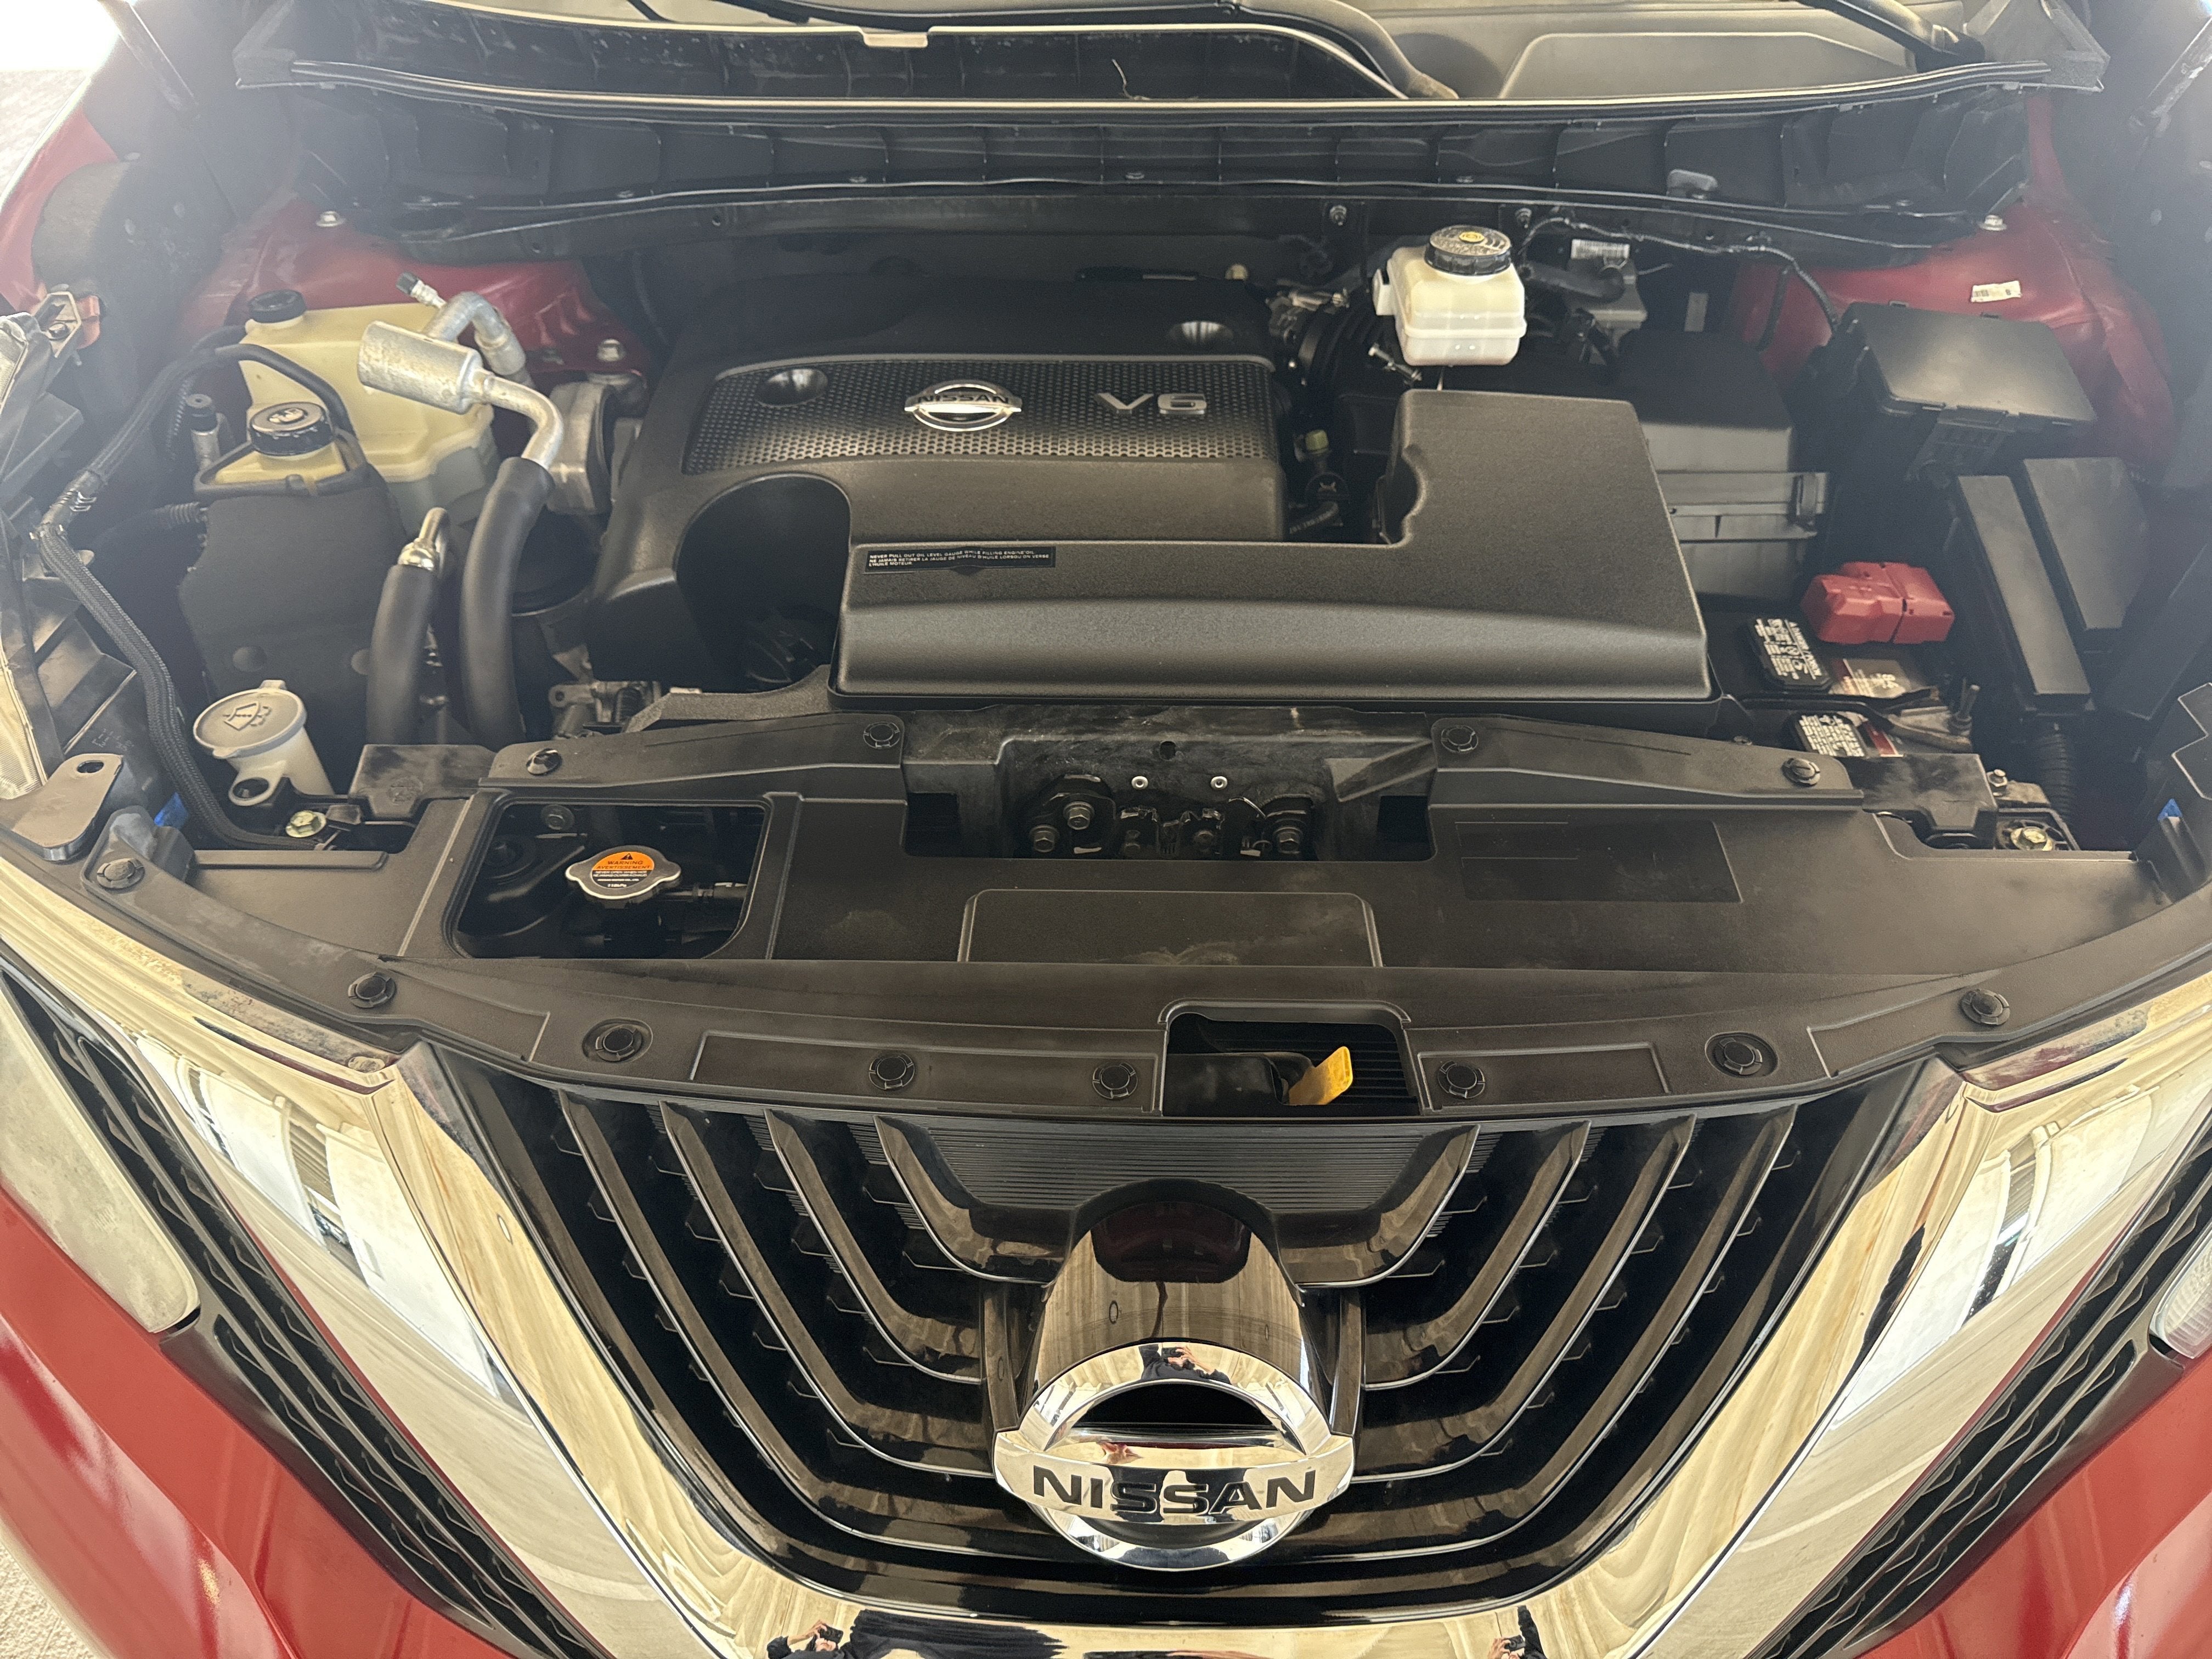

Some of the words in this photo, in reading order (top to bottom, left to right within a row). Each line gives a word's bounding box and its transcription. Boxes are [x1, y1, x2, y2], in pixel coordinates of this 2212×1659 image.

[917, 394, 1009, 404] NISSAN
[1098, 392, 1207, 414] V6
[1032, 1465, 1316, 1514] NISSAN
